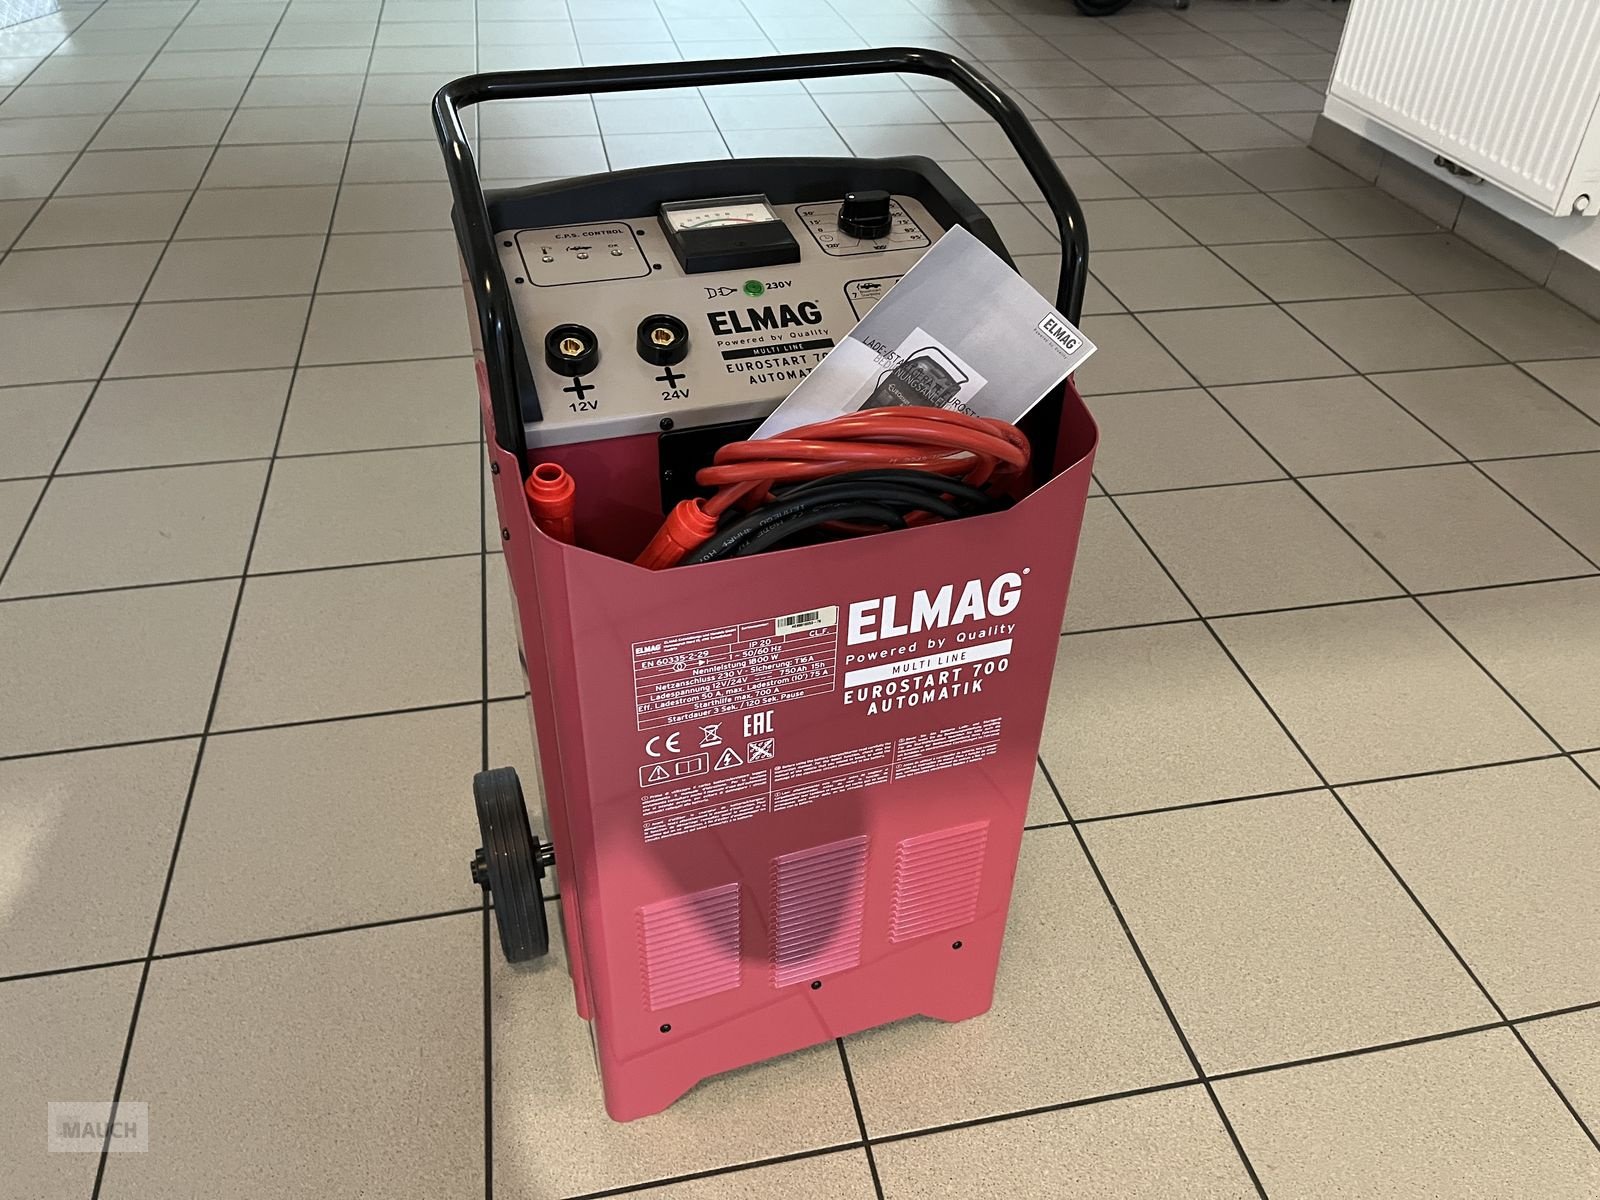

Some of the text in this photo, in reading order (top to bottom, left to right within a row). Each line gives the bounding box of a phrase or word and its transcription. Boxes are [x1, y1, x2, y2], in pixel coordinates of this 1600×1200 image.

[582, 229, 624, 238] CONTROL
[765, 280, 792, 290] 230V
[706, 301, 823, 336] ELMAG
[716, 329, 830, 348] Powered by Quality
[1043, 318, 1077, 349] ELMAG
[753, 343, 804, 355] MULTI LINE
[726, 355, 807, 374] EUROSTART
[661, 388, 690, 402] 24V
[569, 399, 599, 413] 12V
[846, 572, 1022, 646] ELMAG
[635, 643, 662, 655] ELMAG
[742, 647, 769, 658] 50/60
[760, 638, 772, 647] 20
[845, 623, 1015, 665] Powered by Quality
[641, 660, 654, 669] EN
[656, 650, 709, 666] 60335-2-29
[692, 661, 746, 676] Nennleistung
[748, 656, 769, 665] 1800
[891, 651, 967, 675] MULTI LINE
[655, 675, 716, 692] Netzanschluss
[717, 670, 735, 680] 230
[736, 669, 743, 677] V
[750, 660, 793, 673] Sicherung:
[844, 658, 1009, 704] EUROSTART 700
[638, 704, 653, 713] Eff.
[655, 695, 699, 709] Ladestrom
[701, 692, 713, 700] 50
[725, 685, 745, 695] max.
[747, 677, 790, 691] Ladestrom
[810, 670, 820, 678] 75
[650, 685, 711, 702] Ladespannung
[712, 677, 748, 690] 12V/24V
[693, 697, 732, 710] Starthilfe
[734, 693, 753, 703] max.
[754, 689, 771, 697] 700
[867, 679, 983, 715] AUTOMATIK
[667, 709, 711, 724] Startdauer
[721, 704, 739, 713] Sek.
[746, 699, 761, 707] 120
[762, 695, 779, 704] Sek.
[780, 690, 805, 700] Pause
